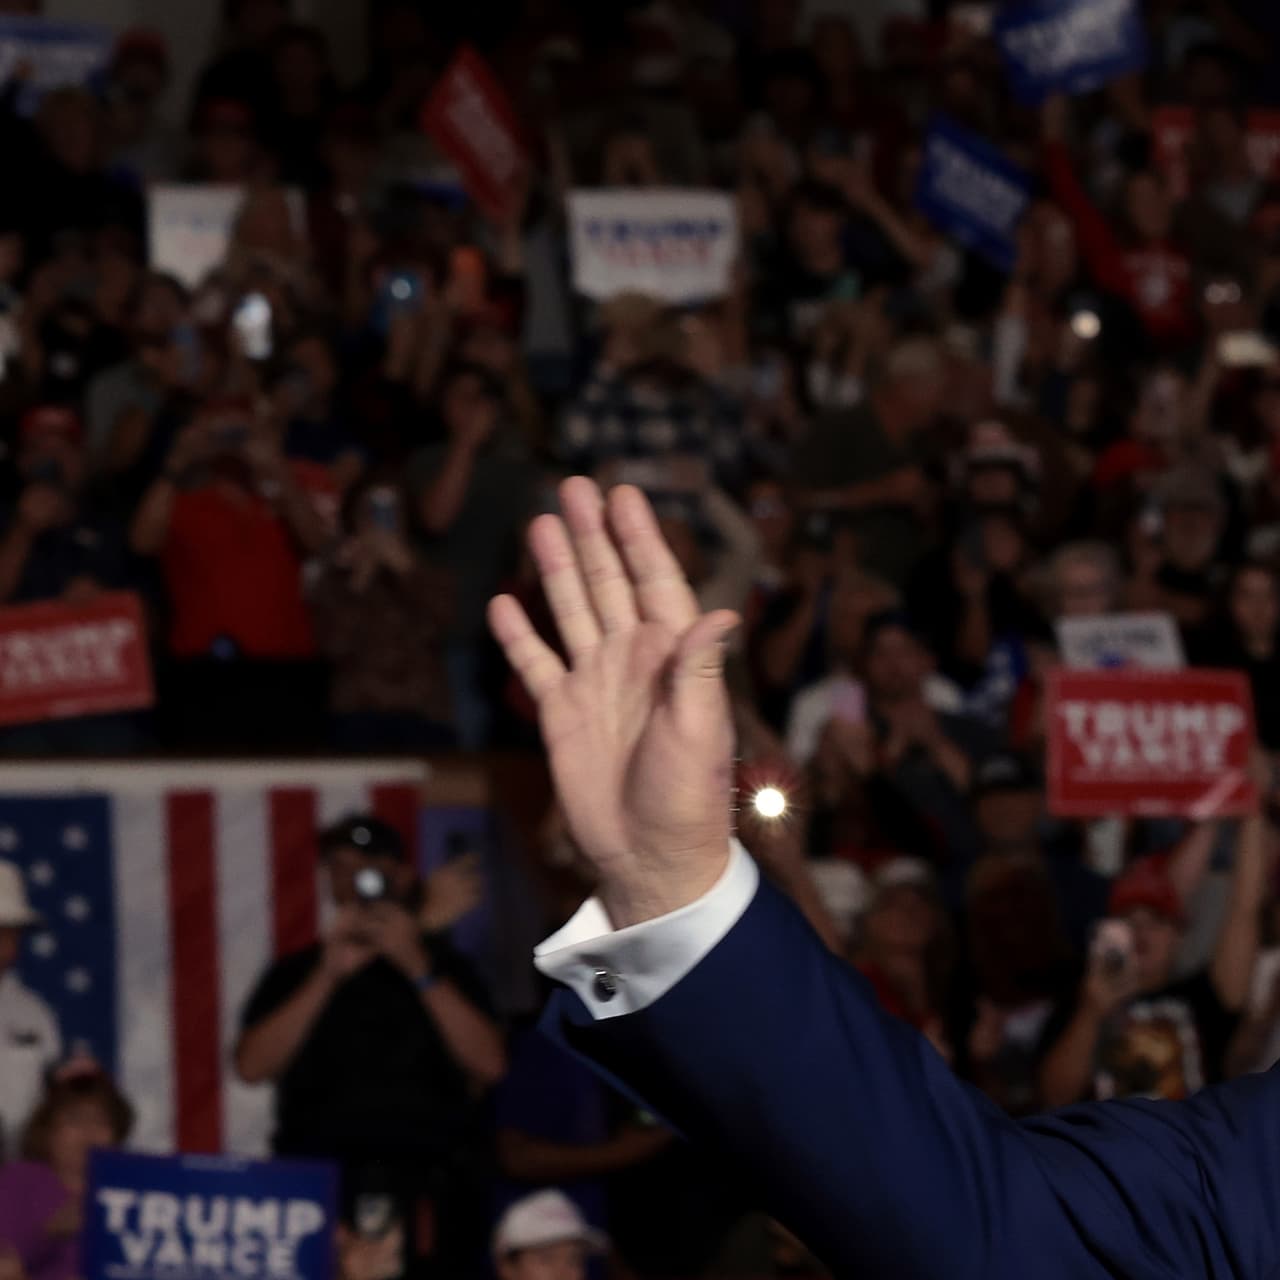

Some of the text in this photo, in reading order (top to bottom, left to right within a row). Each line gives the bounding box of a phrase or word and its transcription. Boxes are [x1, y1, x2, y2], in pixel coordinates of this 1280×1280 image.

[1058, 700, 1246, 740] TRUMP
[1080, 734, 1232, 772] VANCE
[96, 1186, 326, 1243] TRUMP
[120, 1229, 300, 1277] VANCE
